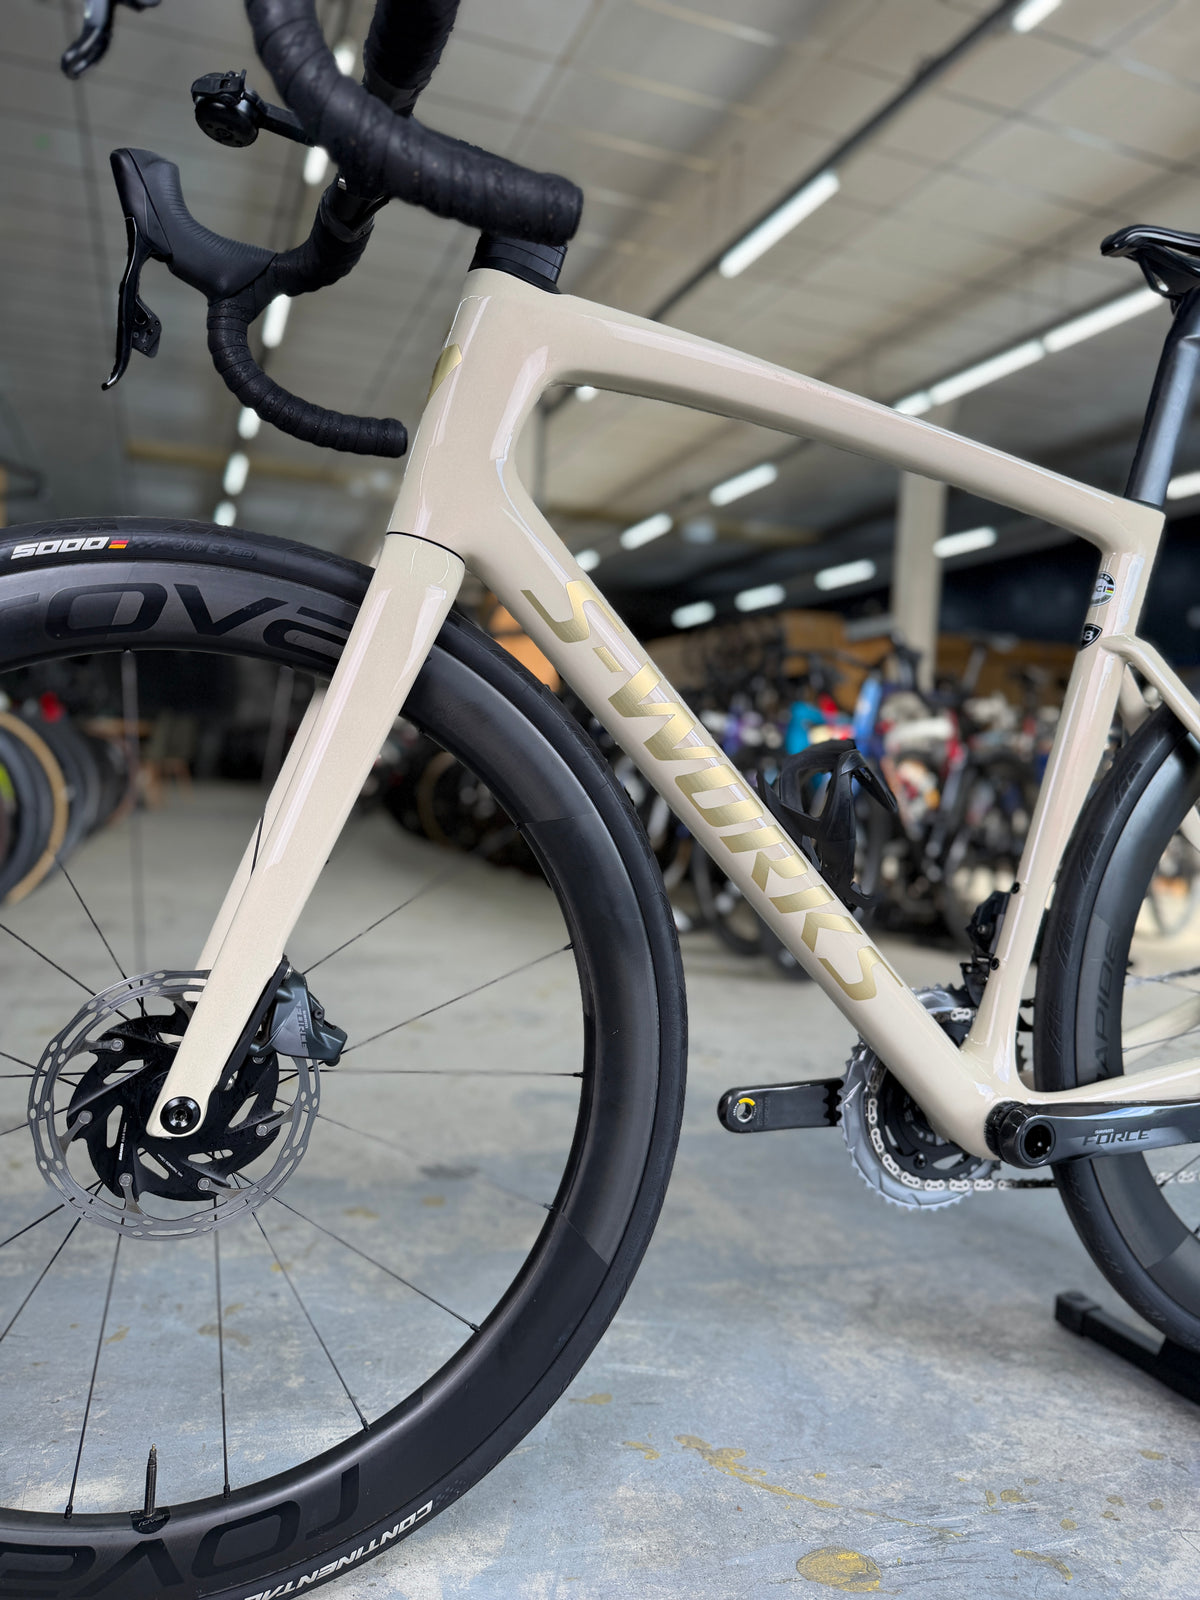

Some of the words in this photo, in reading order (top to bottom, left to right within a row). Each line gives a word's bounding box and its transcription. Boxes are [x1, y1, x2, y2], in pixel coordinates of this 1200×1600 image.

[11, 537, 109, 559] 5000
[521, 580, 903, 1000] S-WORKS
[1095, 927, 1116, 1081] APIDE
[1082, 1130, 1149, 1146] FORCE
